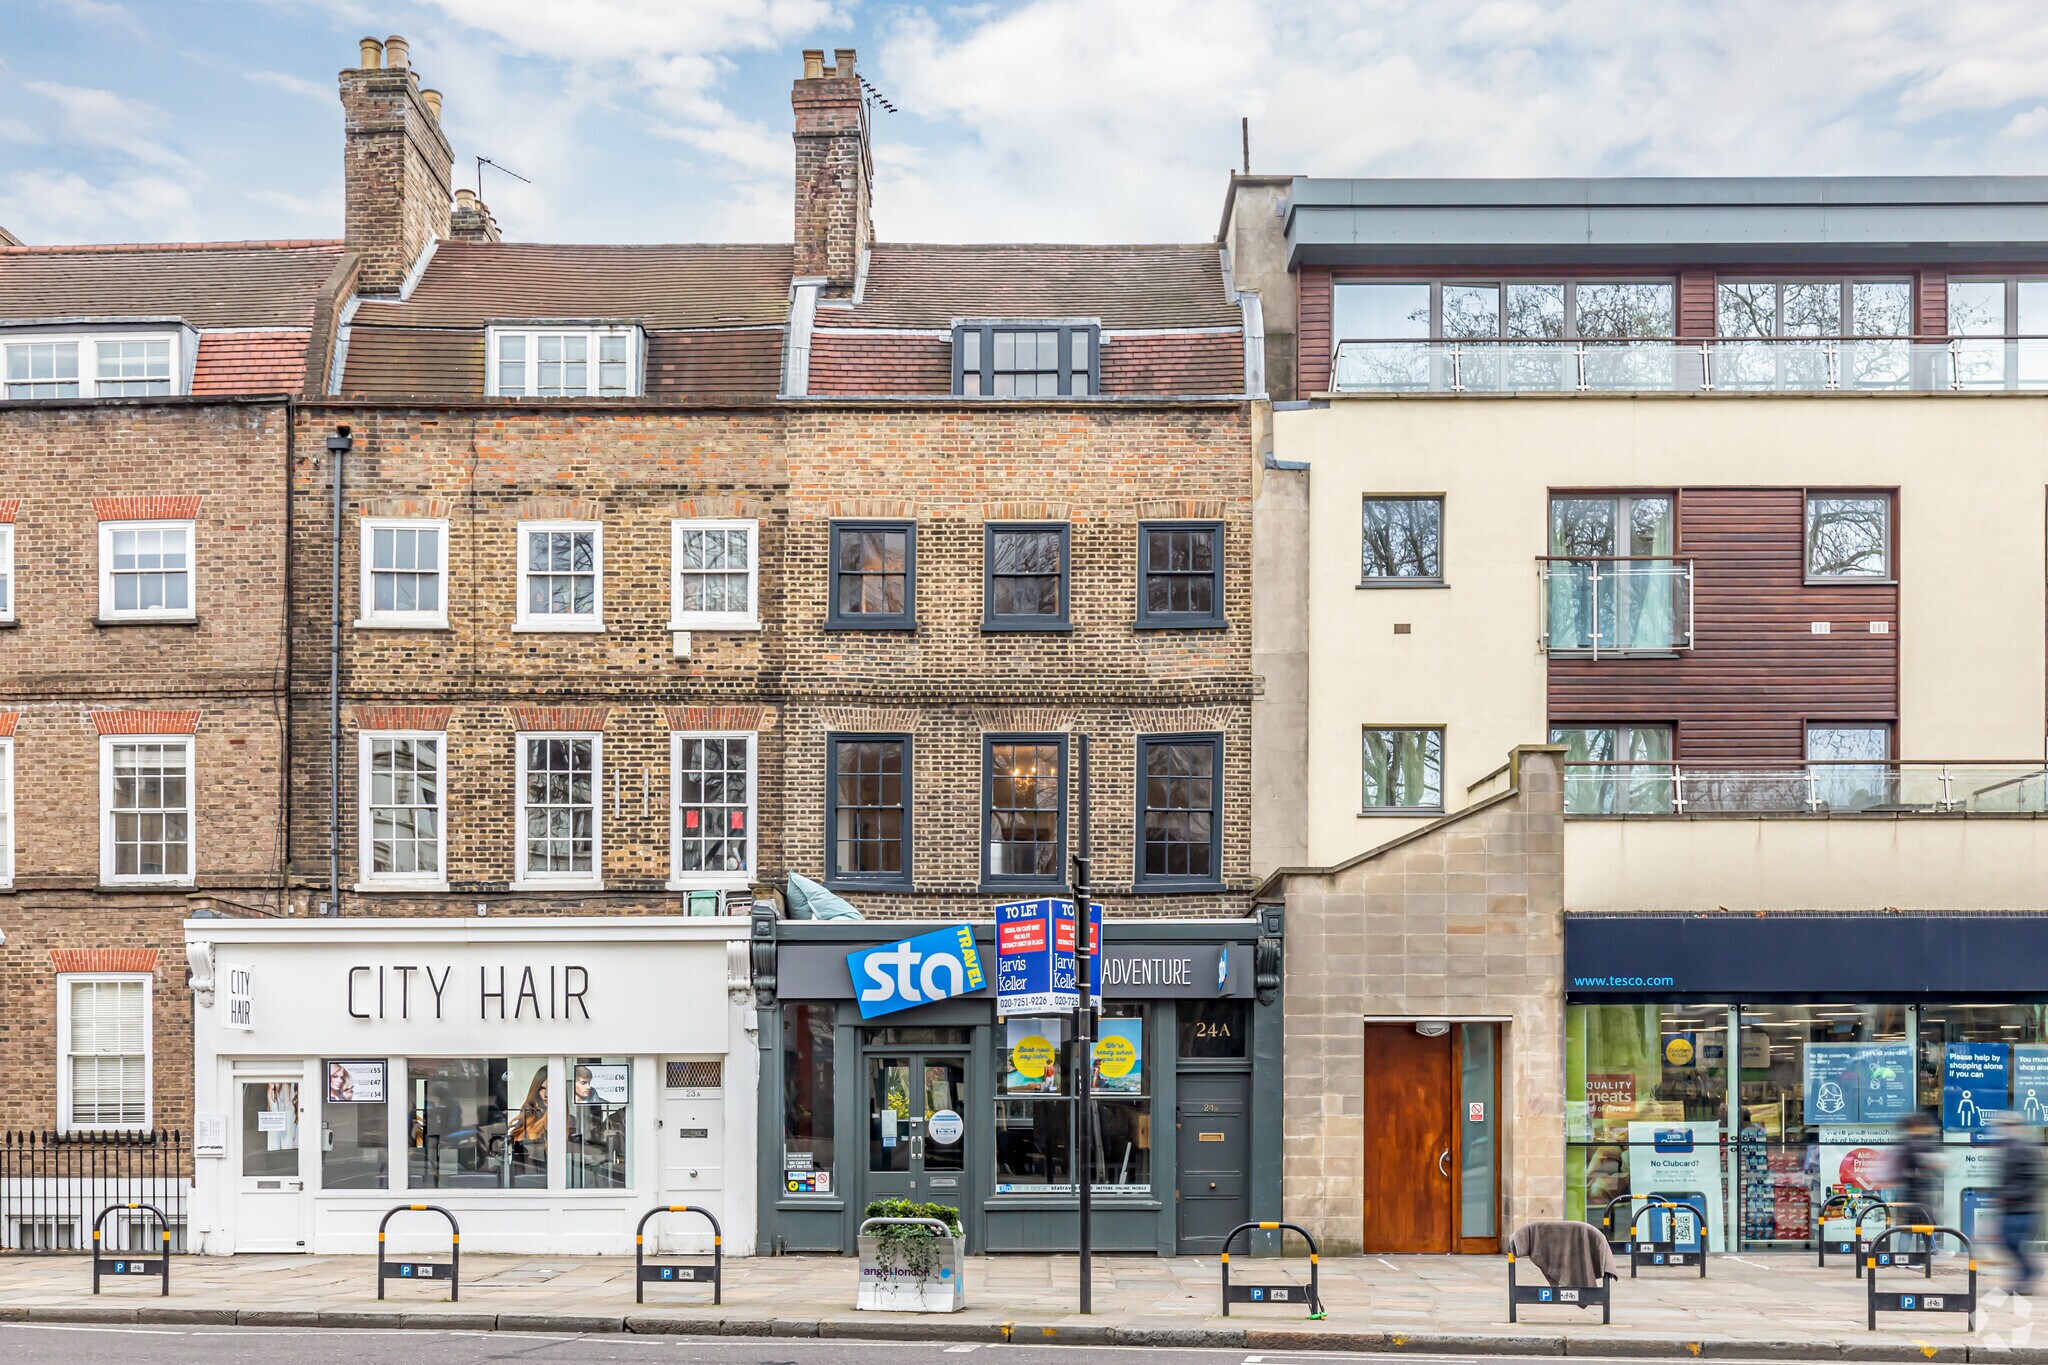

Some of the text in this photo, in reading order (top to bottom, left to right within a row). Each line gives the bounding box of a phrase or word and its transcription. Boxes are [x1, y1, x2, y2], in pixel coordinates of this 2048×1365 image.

[1005, 904, 1038, 919] TO LET
[957, 926, 983, 988] TRAVEL
[1054, 953, 1075, 972] Jarvi
[861, 941, 963, 1001] sta
[999, 956, 1026, 976] Jarvis
[1102, 958, 1191, 985] ADVENTURE
[231, 969, 250, 995] CITY
[999, 975, 1027, 991] Keller
[1054, 972, 1076, 989] Kelle
[1574, 976, 1674, 986] www.tesco.com
[348, 965, 590, 1020] CITY HAIR
[1000, 996, 1047, 1008] 020-7251-9226
[231, 1000, 250, 1025] HAIR
[1196, 1022, 1231, 1038] 24A
[1949, 1053, 2001, 1062] Please help by
[1949, 1062, 2003, 1070] shopping alone
[1586, 1081, 1632, 1089] QUALITY
[1586, 1090, 1632, 1102] meats
[1606, 1104, 1631, 1113] flavour
[1656, 1255, 1662, 1263] P
[1882, 1255, 1888, 1263] P
[117, 1263, 124, 1272] P
[403, 1265, 410, 1274] P
[664, 1269, 670, 1278] P
[1254, 1289, 1261, 1299] P
[1542, 1291, 1550, 1300] P
[1905, 1297, 1913, 1307] P
